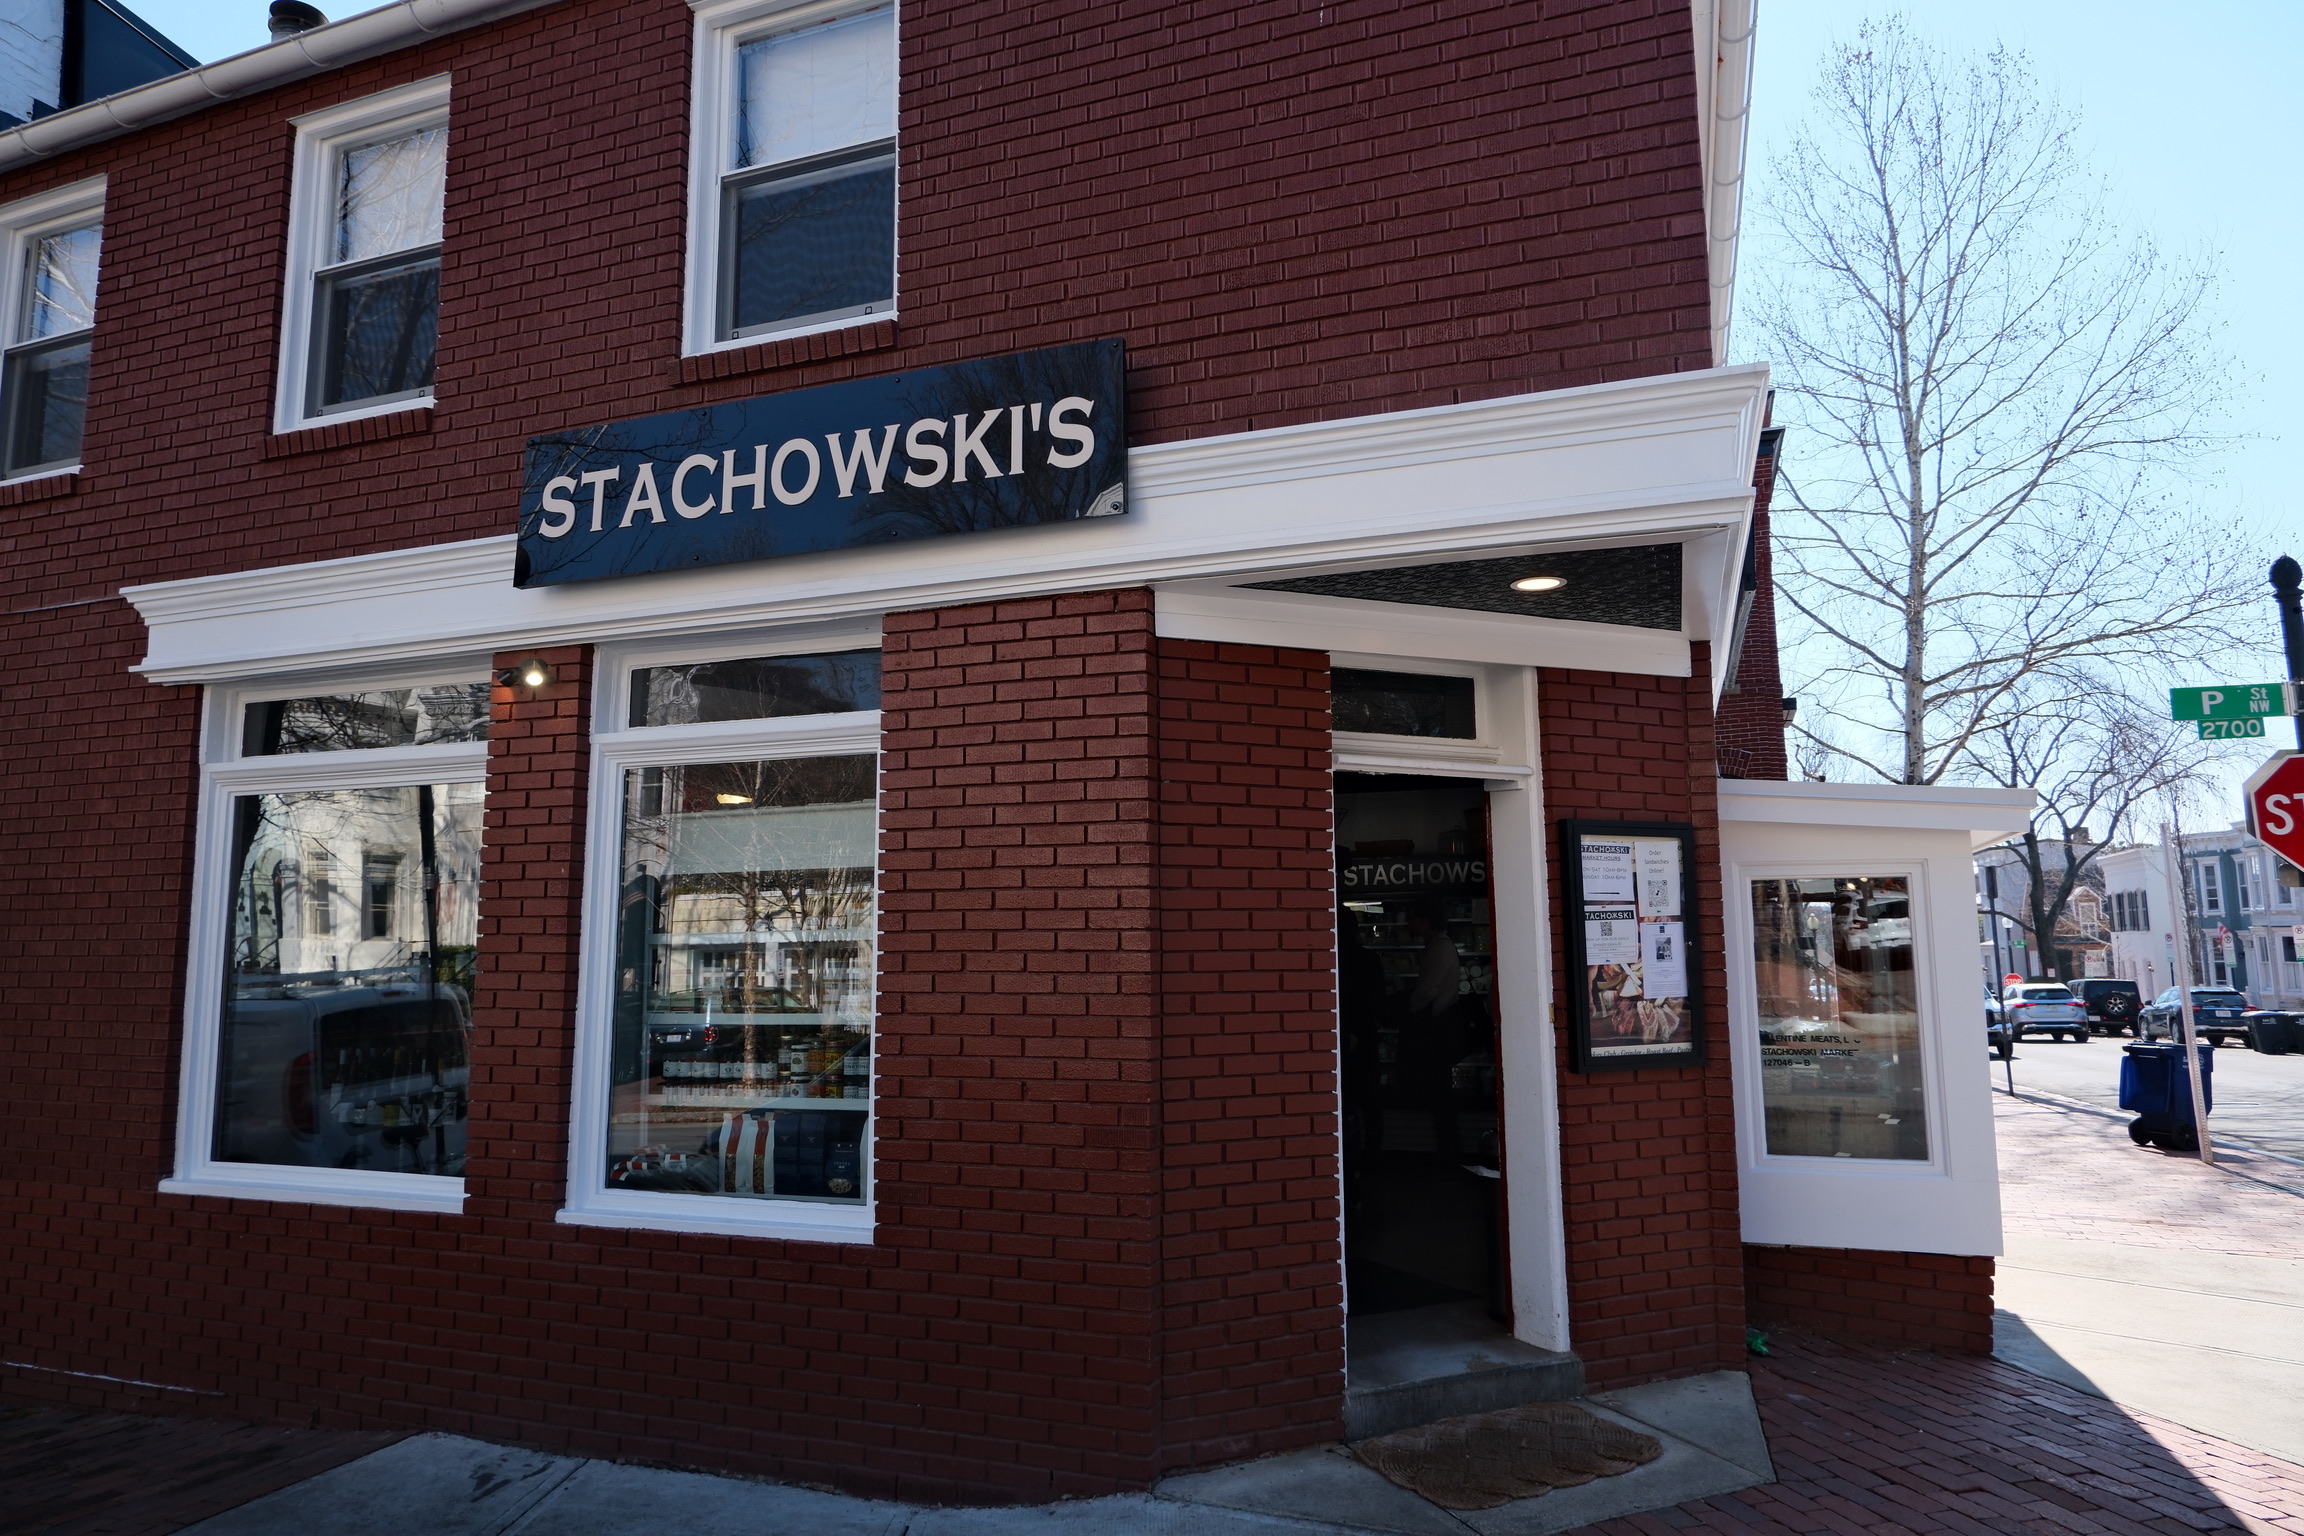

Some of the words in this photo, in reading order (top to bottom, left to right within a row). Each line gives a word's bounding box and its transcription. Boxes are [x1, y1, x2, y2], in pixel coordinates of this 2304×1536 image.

[538, 396, 1096, 539] STACHOWSKI'S
[2201, 691, 2224, 715] P
[2250, 687, 2268, 700] St
[2249, 700, 2270, 713] NW
[2202, 719, 2261, 739] 2700
[1344, 860, 1486, 886] STACHOWS
[2005, 978, 2022, 986] STOP
[1761, 1047, 1817, 1056] STACHOWSKI
